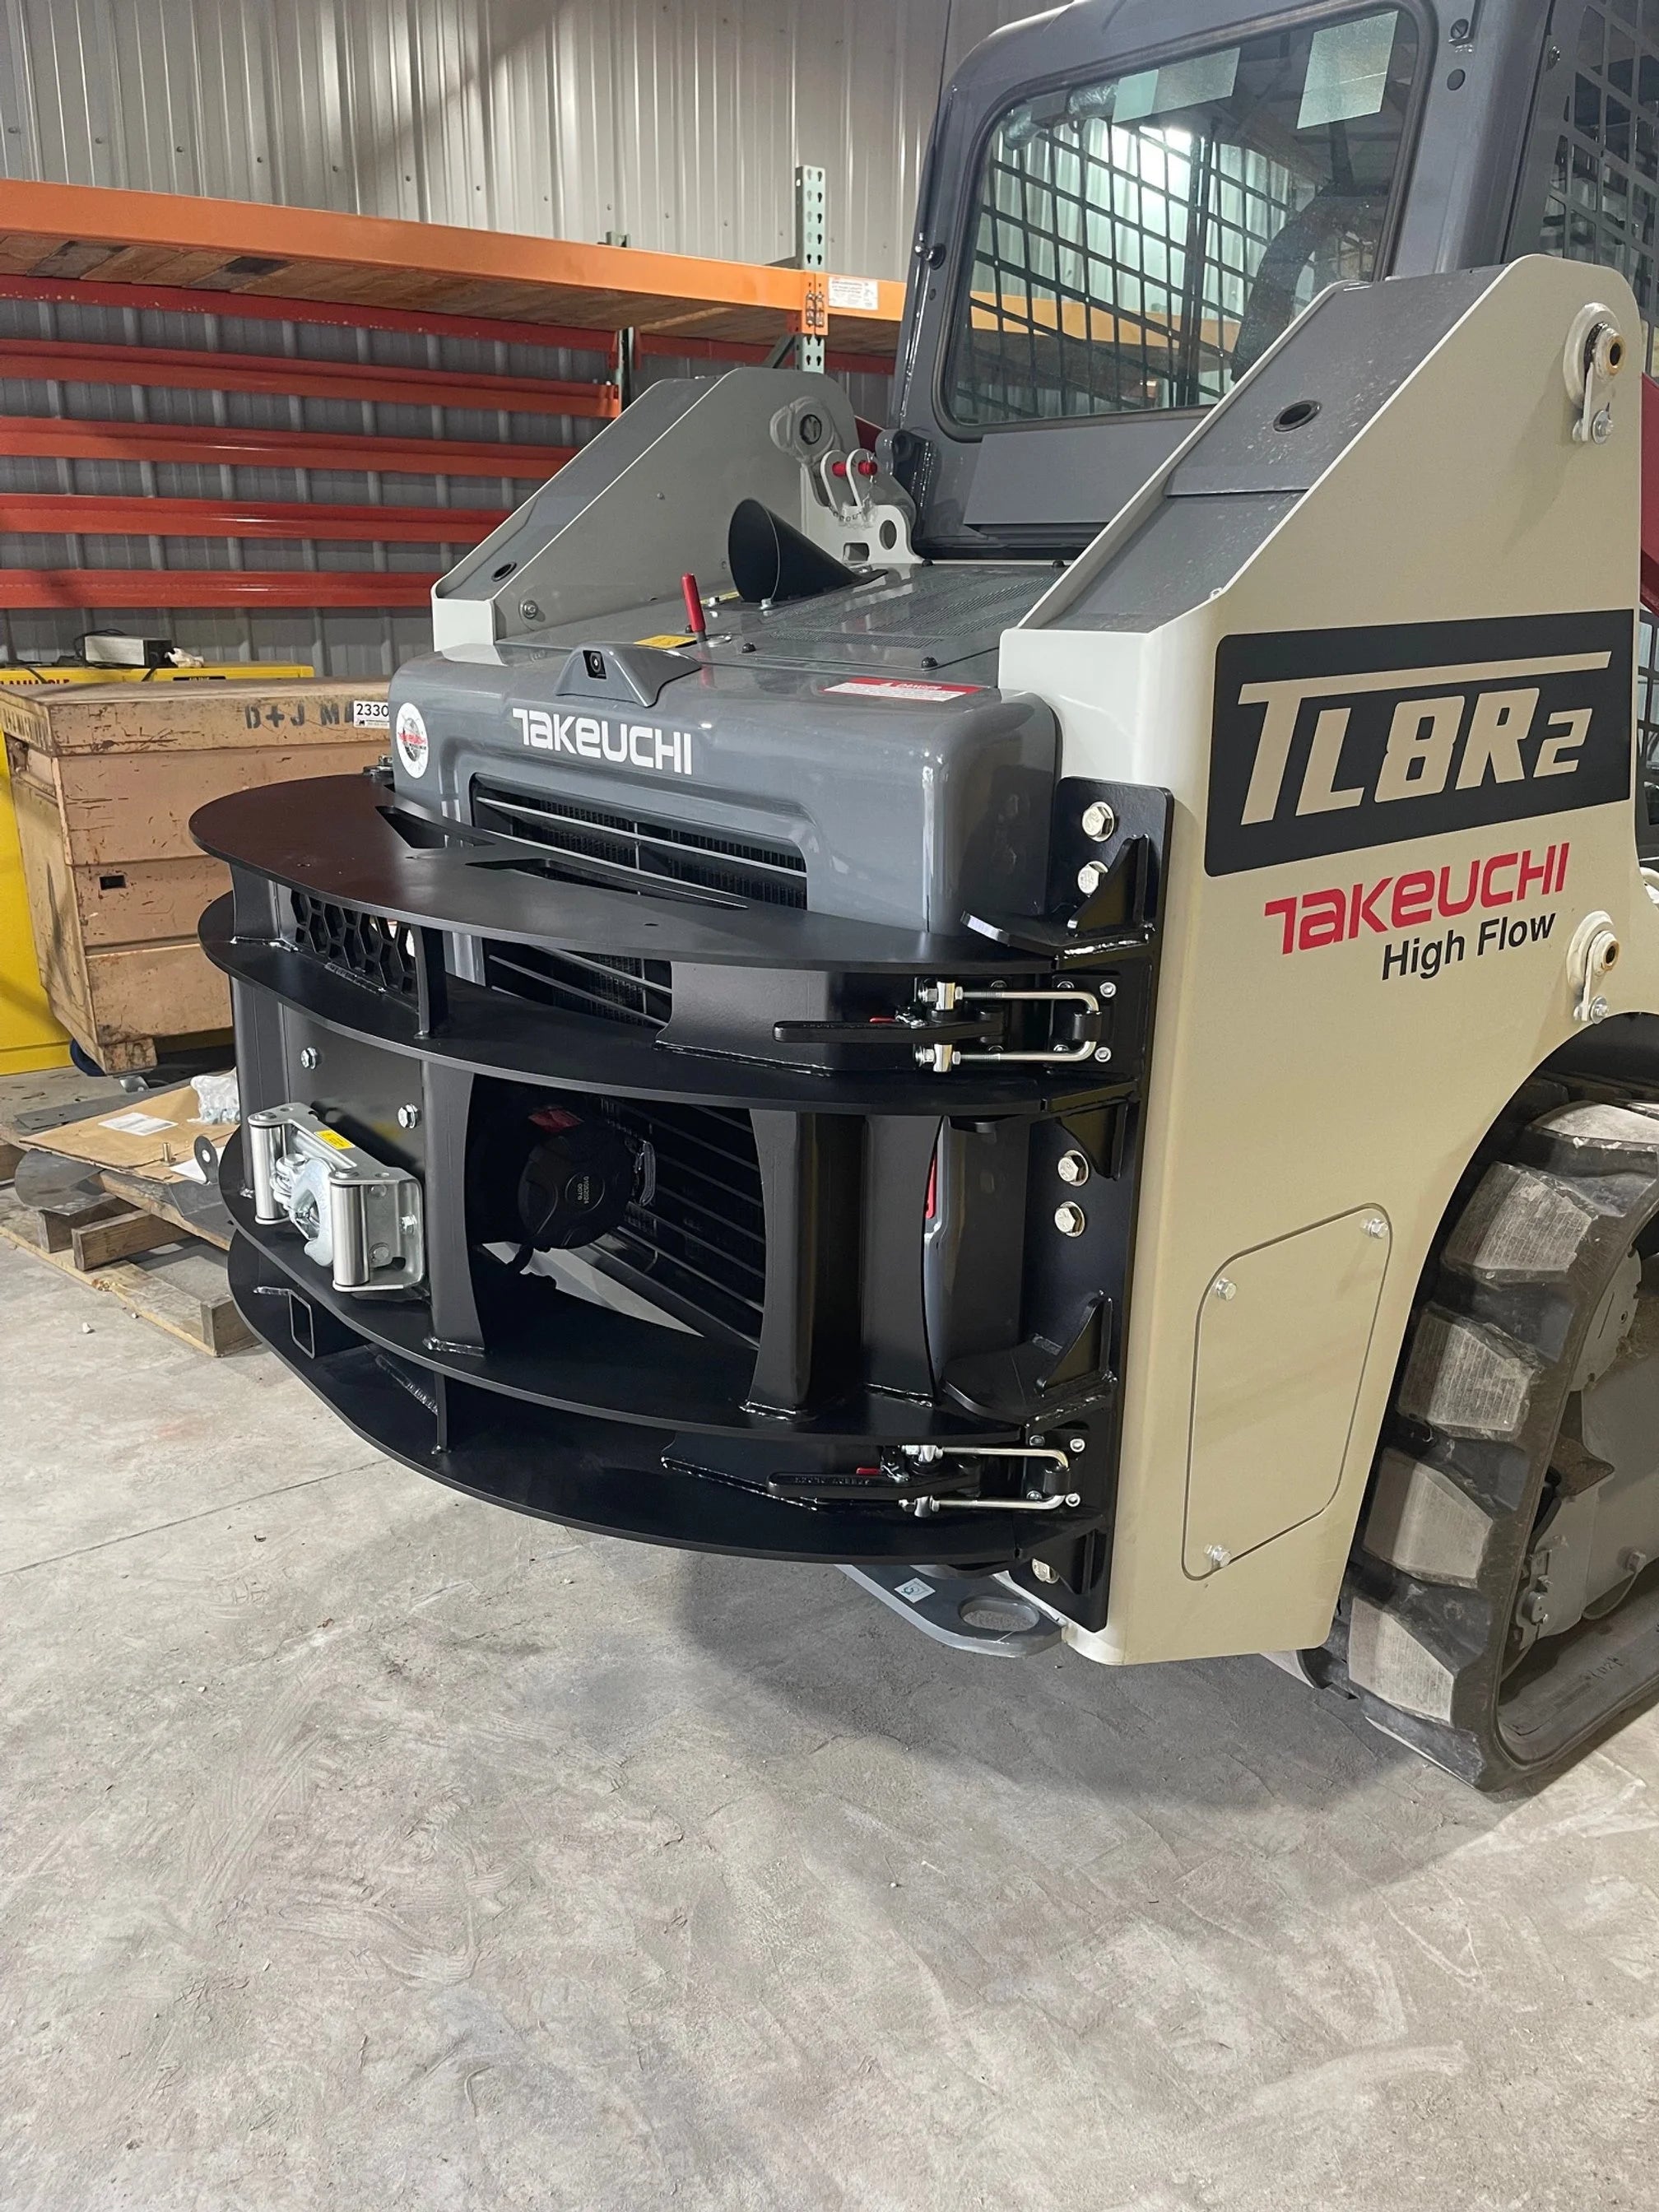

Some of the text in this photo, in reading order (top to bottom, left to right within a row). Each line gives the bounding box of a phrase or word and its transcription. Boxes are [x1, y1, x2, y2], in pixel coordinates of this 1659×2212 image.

[356, 703, 389, 718] 2330
[1238, 650, 1612, 825] TL8R2
[1381, 913, 1557, 981] High Flow
